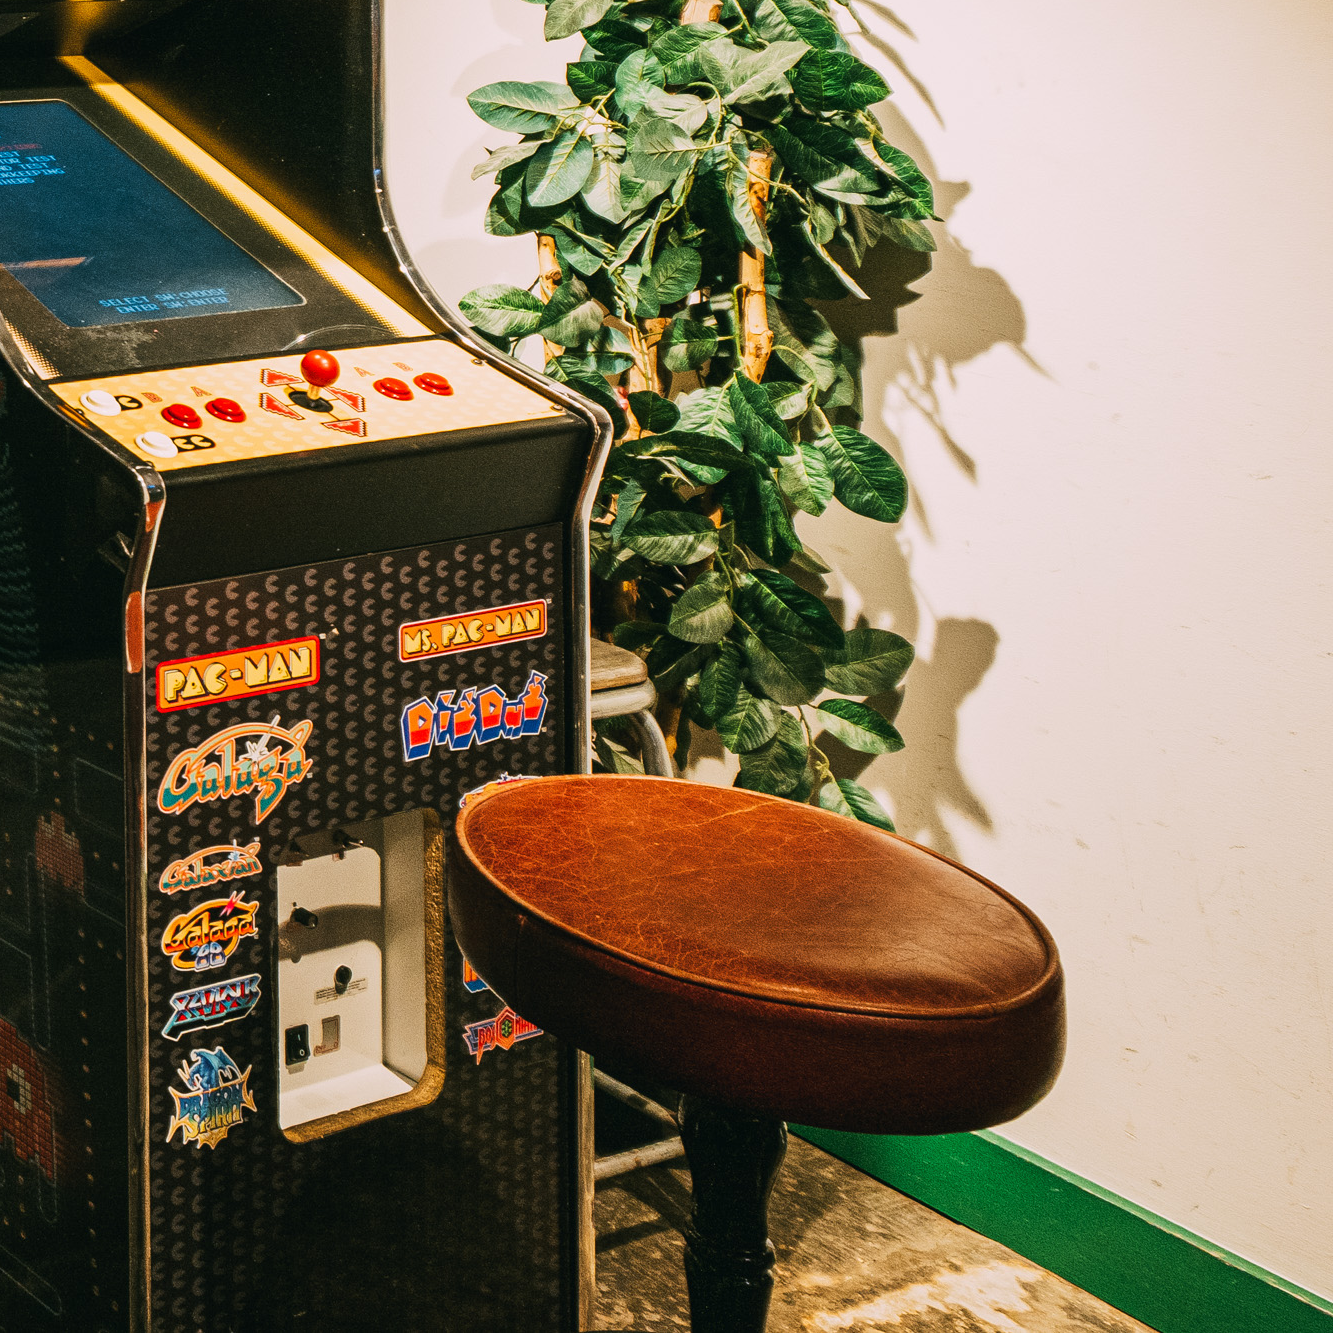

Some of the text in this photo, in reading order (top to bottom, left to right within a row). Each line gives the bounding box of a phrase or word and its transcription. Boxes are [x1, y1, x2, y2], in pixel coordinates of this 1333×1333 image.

[98, 295, 150, 308] SELECT
[354, 366, 374, 378] A
[190, 386, 212, 398] A
[404, 608, 540, 654] MS. PAC-MAN
[164, 646, 312, 703] PAC-MAN
